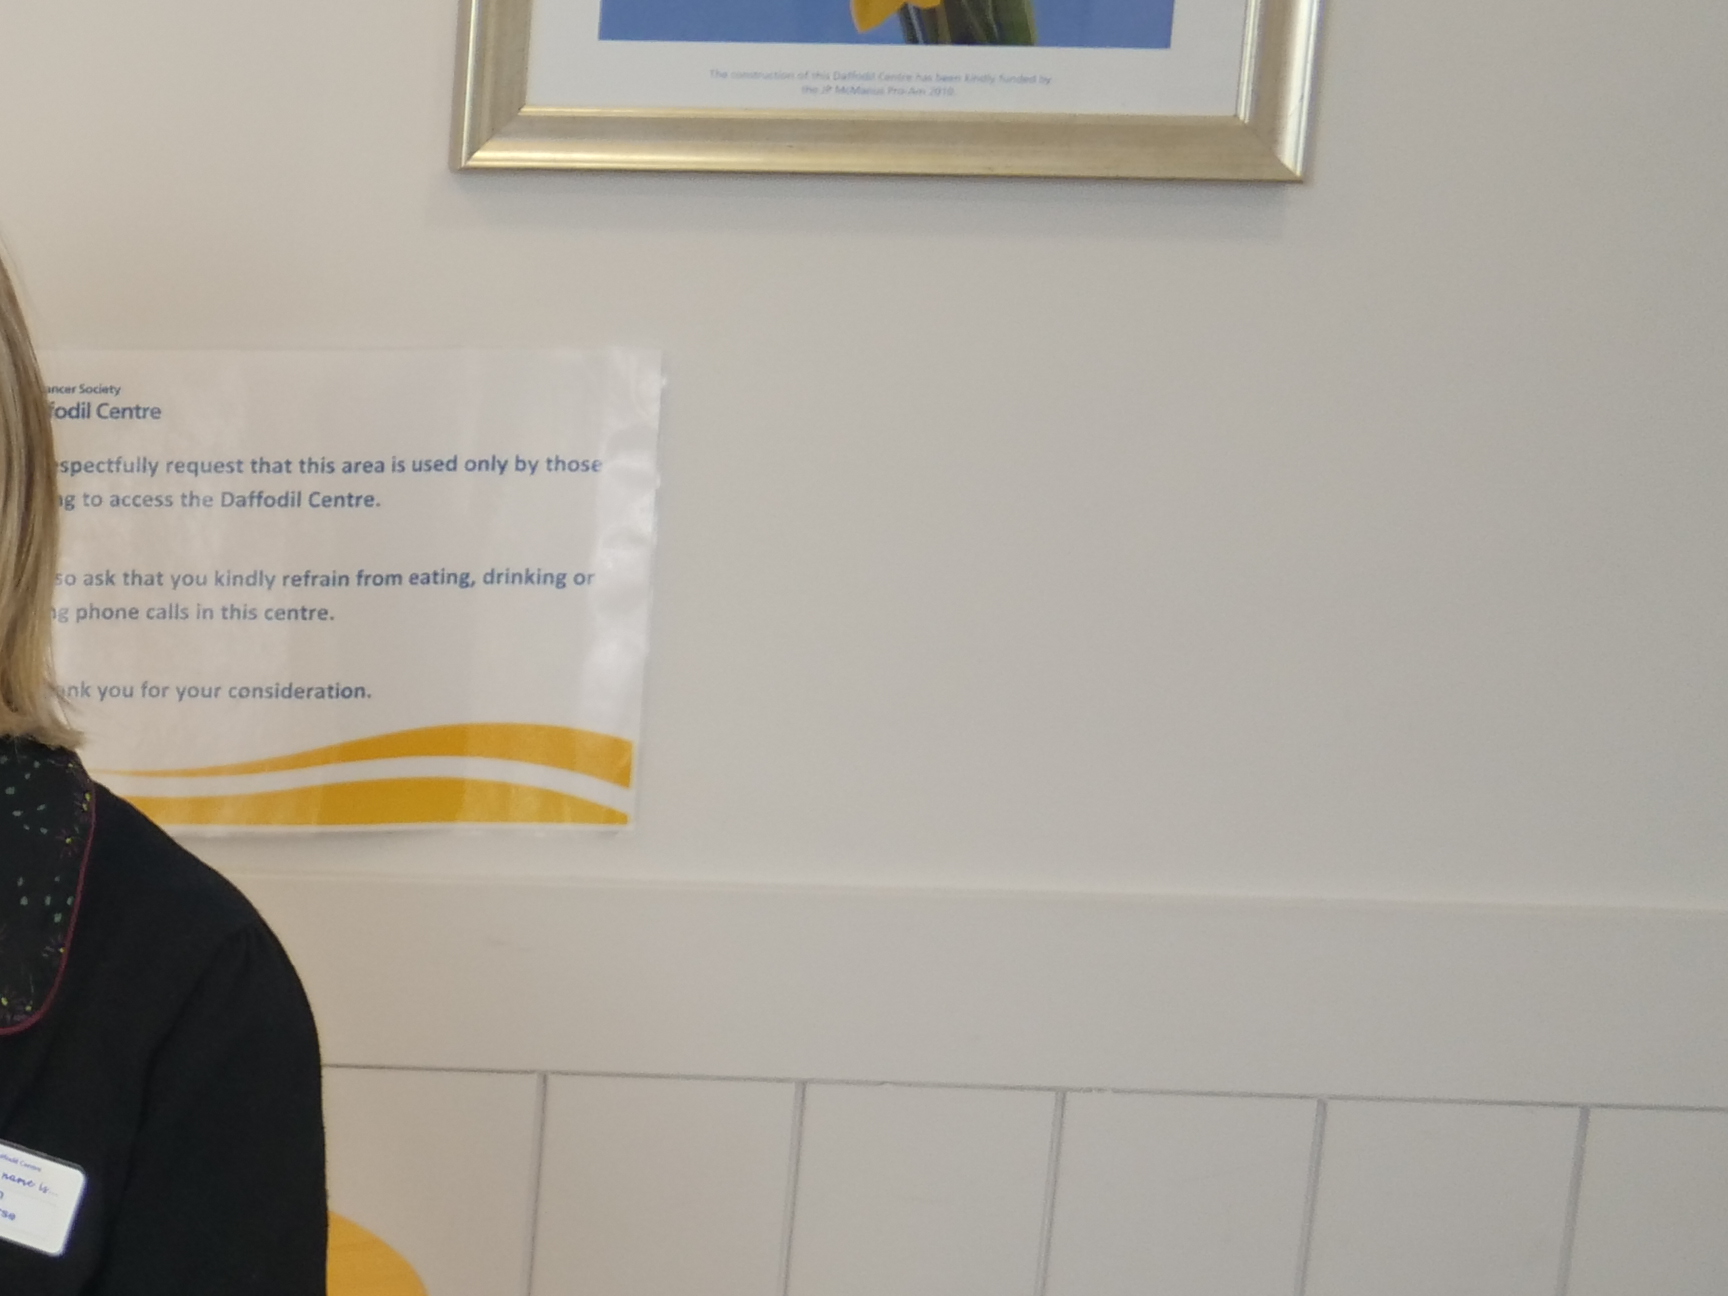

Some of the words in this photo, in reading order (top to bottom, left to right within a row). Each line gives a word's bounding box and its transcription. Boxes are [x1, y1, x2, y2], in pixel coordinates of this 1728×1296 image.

[79, 384, 121, 396] Society
[96, 402, 162, 420] Centre
[166, 458, 244, 477] request
[250, 457, 292, 474] that
[299, 457, 335, 474] this
[342, 458, 385, 474] area
[392, 456, 406, 473] is
[412, 455, 458, 472] used
[464, 455, 508, 475] only
[514, 456, 538, 476] by
[546, 456, 602, 472] those
[83, 493, 103, 507] to
[109, 493, 174, 507] access
[181, 491, 213, 507] the
[220, 491, 302, 508] Daffodil
[308, 492, 380, 508] Centre.
[83, 569, 115, 587] ask
[122, 570, 164, 587] that
[171, 573, 207, 589] you
[214, 570, 276, 589] kindly
[282, 570, 350, 587] refrain
[356, 570, 402, 586] from
[408, 568, 476, 588] eating,
[482, 568, 567, 589] drinking
[573, 572, 595, 586] or
[76, 604, 139, 623] phone
[146, 603, 189, 620] calls
[196, 604, 213, 620] in
[221, 604, 257, 621] this
[264, 606, 334, 621] centre.
[97, 685, 134, 701] you
[141, 682, 169, 699] for
[176, 685, 221, 702] your
[228, 683, 372, 700] consideration.
[2, 1171, 35, 1187] name
